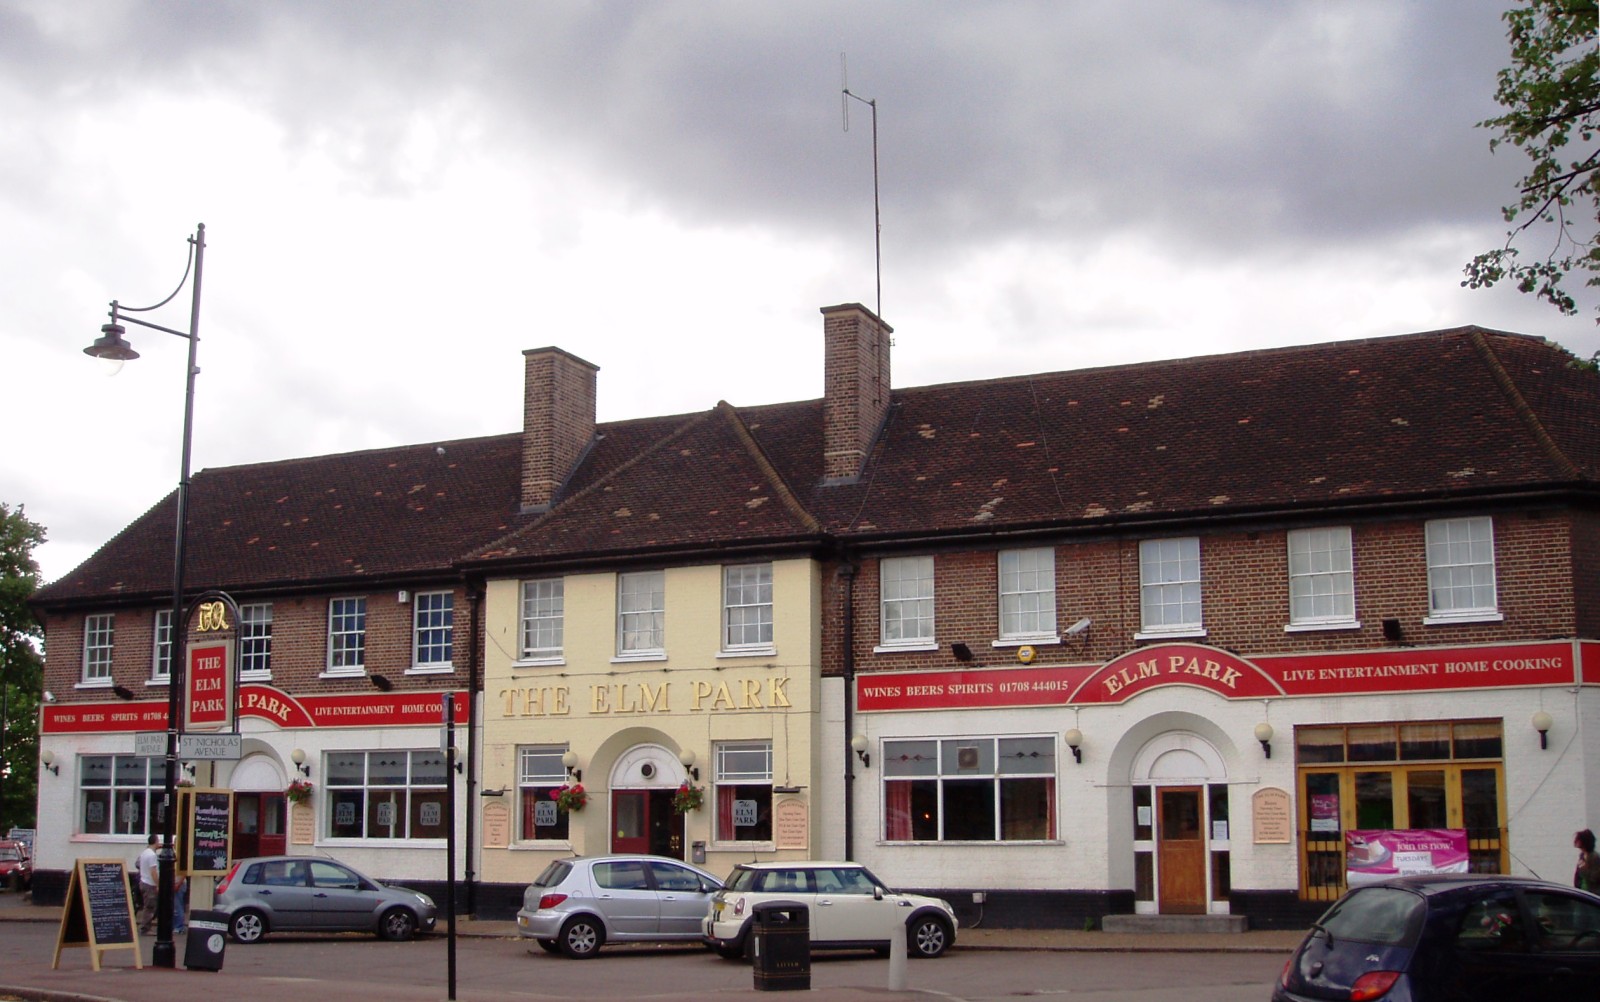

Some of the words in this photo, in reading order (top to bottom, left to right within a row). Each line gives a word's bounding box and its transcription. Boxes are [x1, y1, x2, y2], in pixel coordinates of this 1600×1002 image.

[197, 656, 221, 670] THE
[1283, 670, 1315, 681] LIVE
[1319, 663, 1438, 680] ENTERTAINMENT
[1444, 660, 1489, 673] HOME
[1492, 657, 1562, 671] COOKING
[1102, 659, 1160, 695] ELM
[1168, 656, 1243, 689] PARK
[195, 677, 221, 691] ELM
[863, 687, 901, 697] WINES
[906, 685, 943, 696] BEERS
[948, 683, 993, 695] SPIRITS
[1000, 681, 1030, 692] 01708
[1032, 680, 1068, 691] 444015
[500, 685, 570, 717] THE
[589, 682, 671, 714] ELM
[690, 677, 792, 711] PARK
[192, 698, 224, 712] PARK
[247, 692, 292, 721] PARK
[315, 706, 331, 716] LIVE
[333, 705, 395, 715] ENTERTAINMENT
[401, 703, 424, 713] HOME
[54, 714, 76, 723] WINES
[82, 713, 105, 722] BEERS
[111, 712, 138, 721] SPIRITS
[183, 738, 192, 746] ST
[196, 737, 239, 747] NICHOLAS
[194, 747, 226, 756] AVENUE
[1397, 841, 1415, 851] join
[1430, 840, 1454, 850] now!
